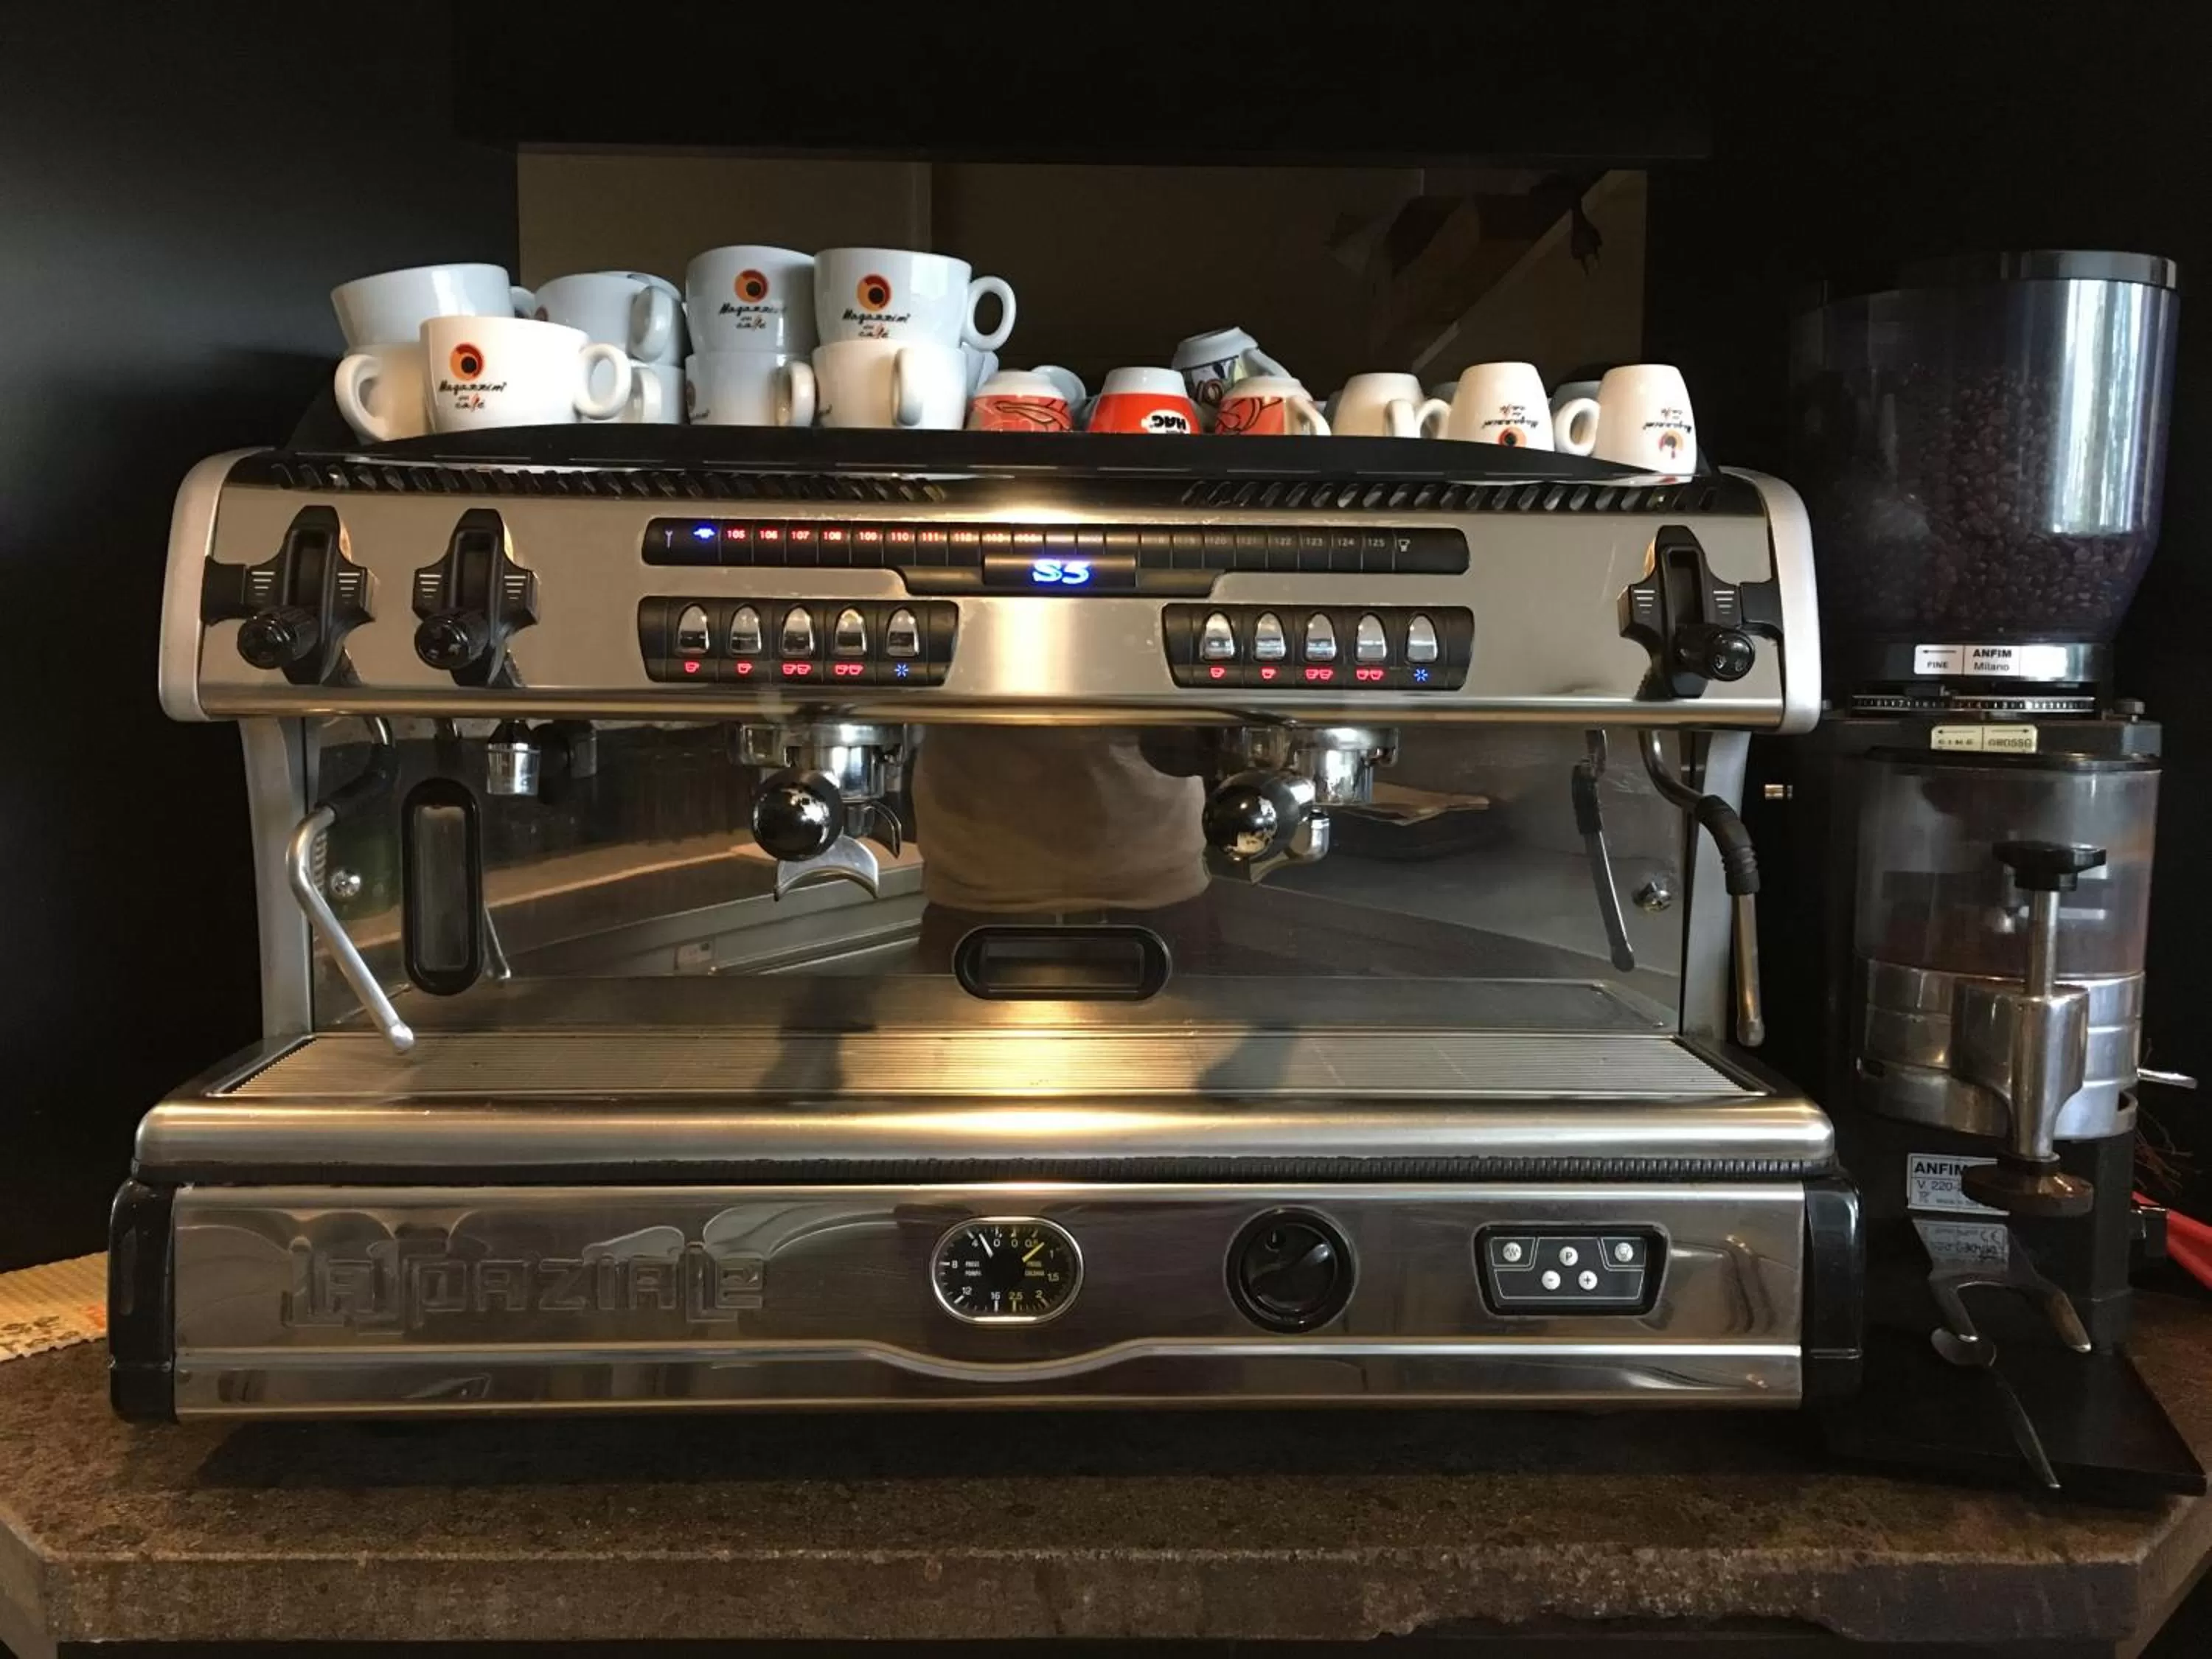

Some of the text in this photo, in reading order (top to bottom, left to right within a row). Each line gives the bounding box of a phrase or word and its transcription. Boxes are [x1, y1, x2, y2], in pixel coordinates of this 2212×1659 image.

[1151, 415, 1186, 430] HAG
[727, 530, 745, 539] 105
[760, 530, 778, 539] 106
[791, 531, 810, 540] 107
[824, 532, 841, 540] 108
[859, 532, 877, 540] 109
[891, 532, 909, 541] 110
[1306, 537, 1323, 546] 123
[1338, 538, 1354, 547] 124
[1368, 538, 1385, 547] 125
[1972, 649, 2012, 658] ANFIM
[1974, 662, 2010, 671] Milano
[971, 1239, 978, 1248] 4
[993, 1239, 1001, 1248] 0
[1011, 1239, 1018, 1248] 0
[1565, 1252, 1573, 1261] P
[951, 1260, 959, 1269] 8
[961, 1287, 972, 1295] 12
[990, 1291, 1001, 1300] 16
[1034, 1290, 1043, 1298] 2
